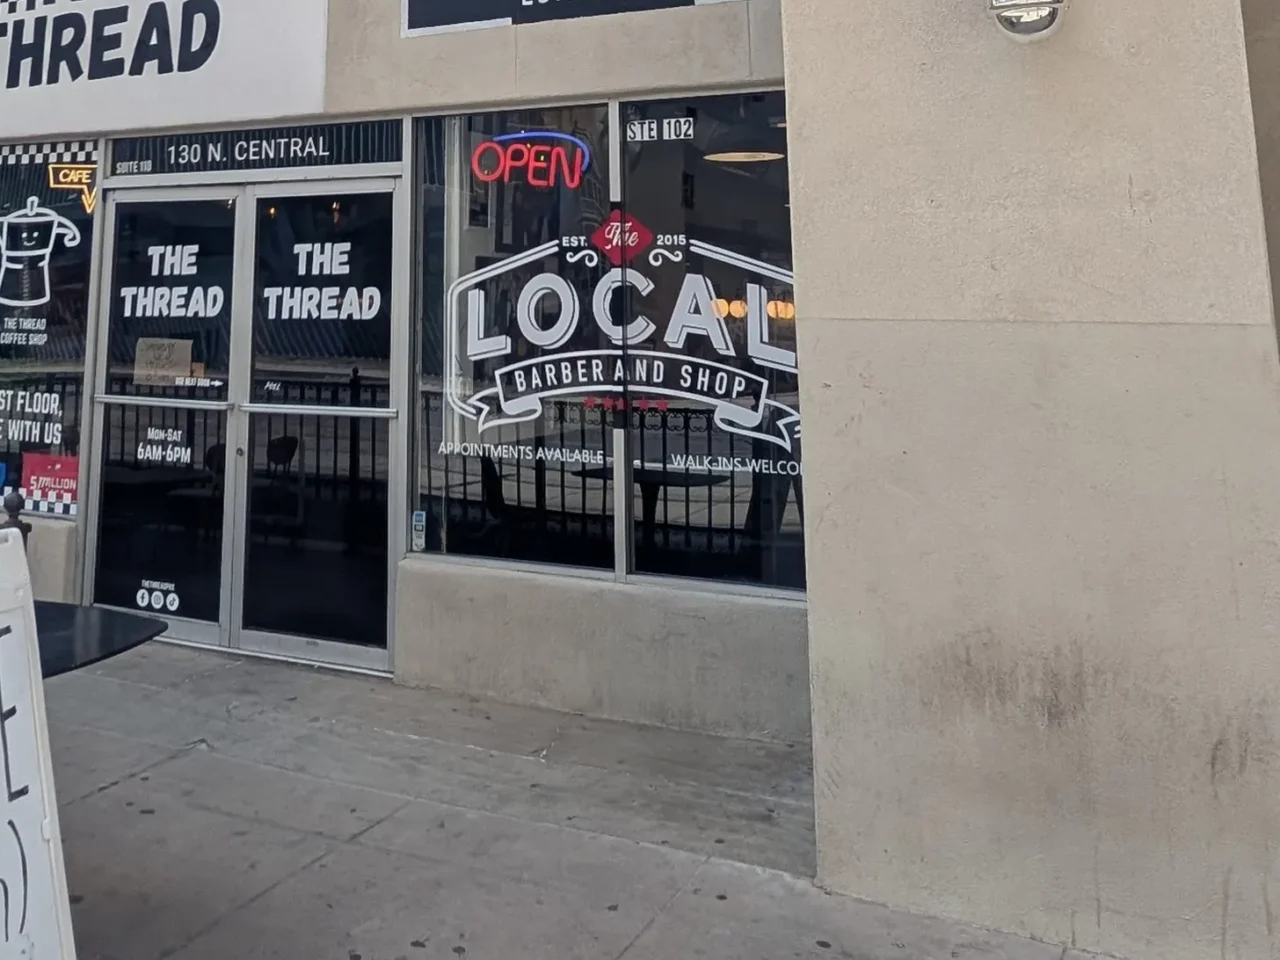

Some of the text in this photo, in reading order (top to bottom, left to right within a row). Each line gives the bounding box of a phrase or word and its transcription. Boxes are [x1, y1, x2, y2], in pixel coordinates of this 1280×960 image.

[627, 118, 693, 140] STE 102
[168, 136, 330, 164] 130 N. CENTRAL
[58, 169, 92, 183] CAFE
[116, 162, 138, 174] SUITE
[472, 142, 582, 189] OPEN
[562, 234, 687, 247] EST. 2015
[604, 222, 639, 249] The
[147, 244, 199, 276] THE
[293, 242, 351, 276] THE
[121, 286, 224, 317] THREAD
[264, 286, 382, 320] THREAD
[4, 317, 47, 331] THE THREAD
[466, 268, 797, 373] LOCAL
[0, 332, 27, 345] COFFEE
[514, 356, 747, 399] BARBER AND SHOP
[16, 390, 63, 419] FLOOR,
[8, 419, 41, 443] WITH
[43, 421, 62, 445] US
[438, 441, 604, 465] APPOINTMENTS AVAILABLE
[671, 453, 803, 476] WALK-INS WELCO
